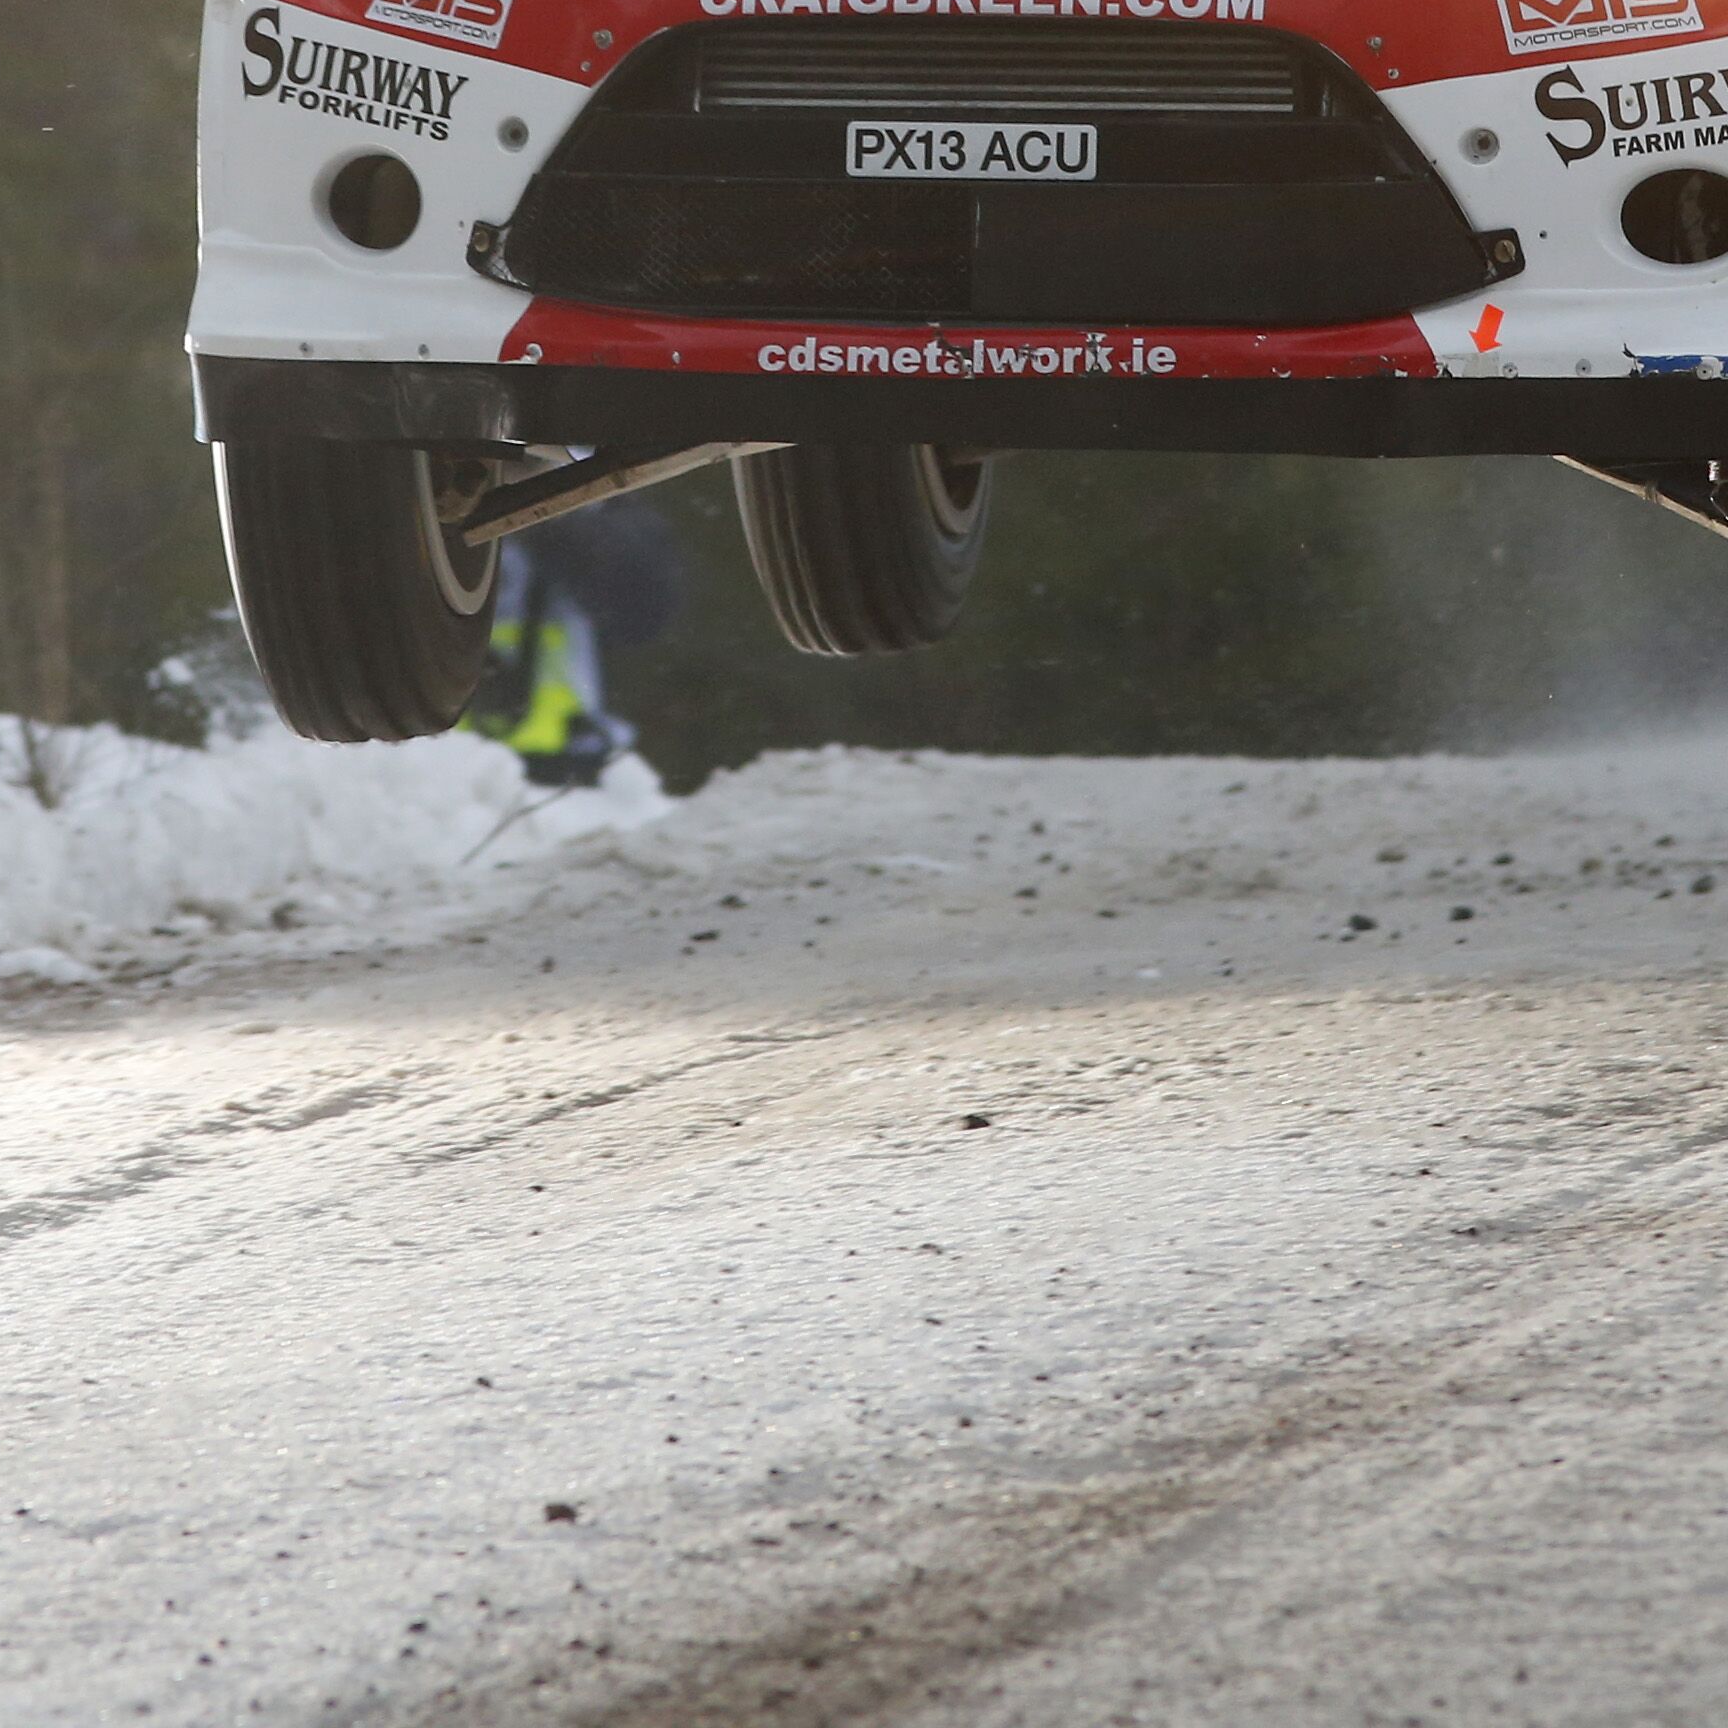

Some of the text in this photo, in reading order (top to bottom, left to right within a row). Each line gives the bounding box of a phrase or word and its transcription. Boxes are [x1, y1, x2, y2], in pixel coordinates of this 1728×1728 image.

[1513, 15, 1698, 49] MOTORSPORT.COM
[241, 6, 470, 121] SUIRWAY
[277, 83, 451, 142] FORKLIFTS
[853, 128, 1089, 173] PX13 ACU
[1612, 130, 1686, 158] FARM
